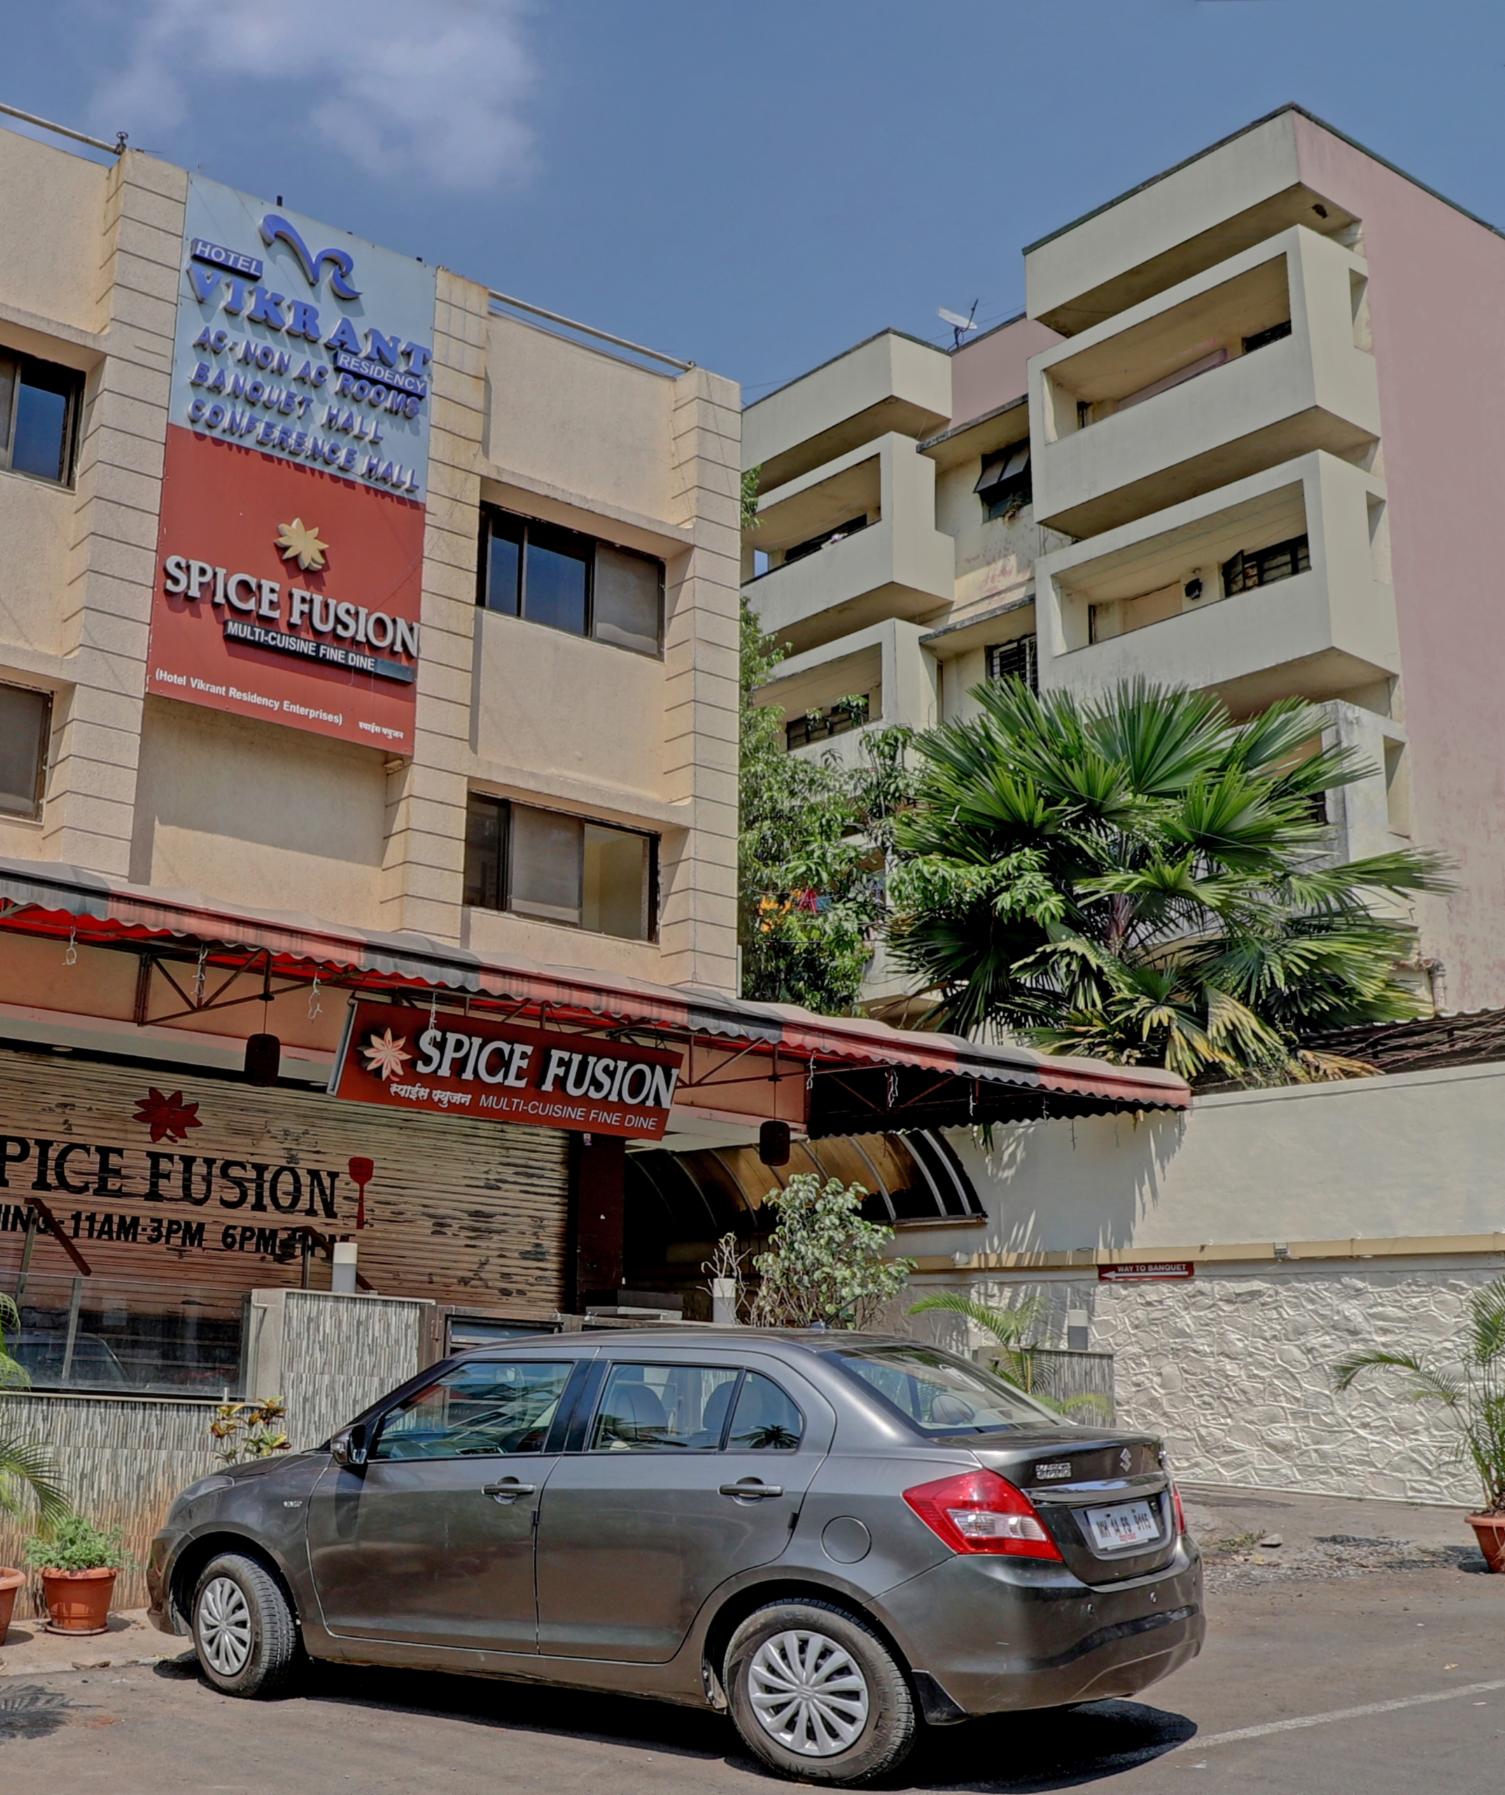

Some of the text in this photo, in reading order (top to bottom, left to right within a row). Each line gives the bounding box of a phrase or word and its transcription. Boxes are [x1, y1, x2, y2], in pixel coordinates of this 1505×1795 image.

[196, 240, 262, 277] HOTEL
[187, 264, 433, 377] VIKRANT
[294, 360, 329, 388] AC
[335, 372, 421, 420] ROOMS
[339, 352, 427, 393] RESIDENCY
[191, 362, 385, 444] BANQUET HALL
[187, 399, 420, 493] CONFERENCE HALL
[164, 555, 421, 659] SPICE FUSION
[227, 621, 376, 671] MULTI-CUISINE FINE DINE
[155, 668, 343, 726] (Hotel Vikrant Residency Enterprises)
[416, 1028, 680, 1110] SPICE FUSION
[479, 1094, 659, 1131] MULTI-CUISINE FINE DINE
[143, 1150, 340, 1220] FUSION
[1148, 1263, 1187, 1272] BANQUET
